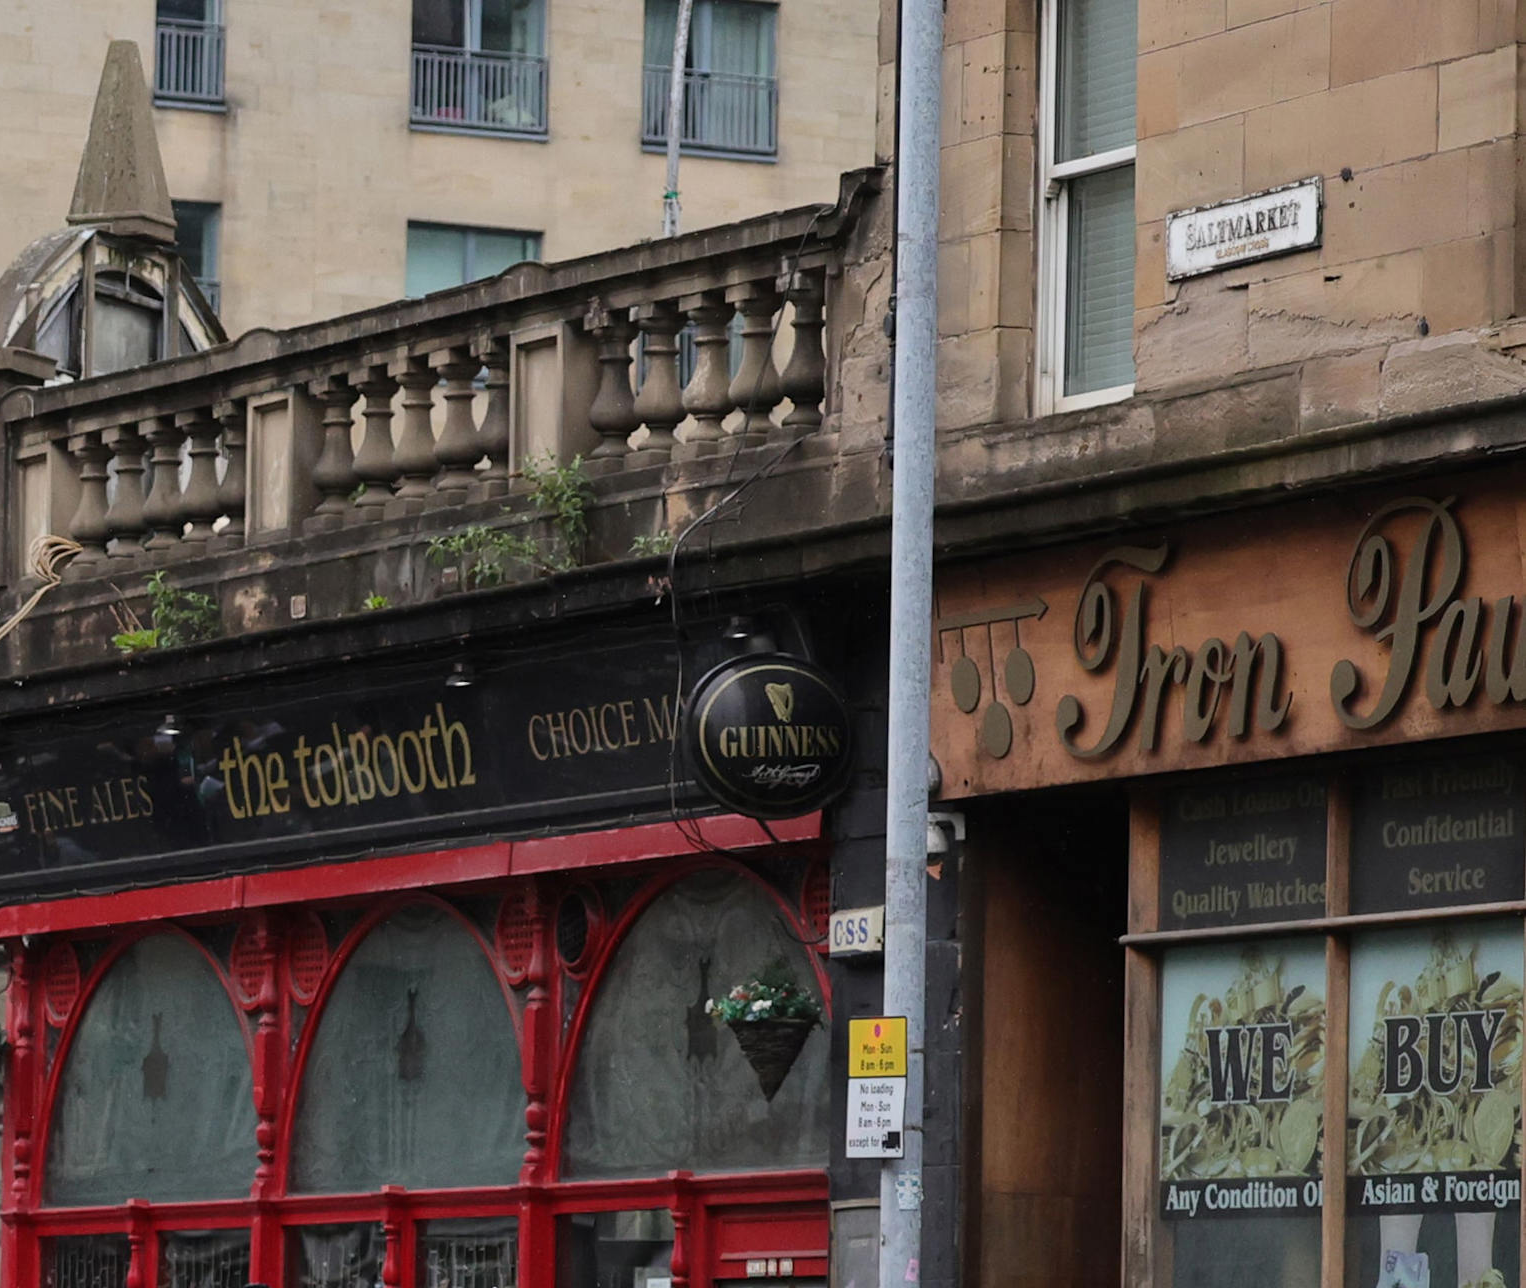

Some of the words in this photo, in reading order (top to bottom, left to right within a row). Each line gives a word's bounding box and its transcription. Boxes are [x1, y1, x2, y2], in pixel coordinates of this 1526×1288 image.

[1186, 200, 1300, 250] SALTMARKET
[528, 701, 640, 761] CHOICE
[719, 725, 842, 758] GUINNESS
[219, 735, 290, 819] the
[24, 789, 82, 834] FINE
[90, 775, 154, 826] ALES
[1383, 809, 1513, 849] Confidential
[1203, 833, 1297, 868] Jewellery
[1172, 885, 1242, 918] Quality
[1247, 878, 1329, 911] Watches
[1408, 868, 1485, 895] Service
[863, 1043, 876, 1053] Mon
[880, 1043, 893, 1053] Sun
[1206, 1022, 1295, 1105] WE
[1384, 1011, 1506, 1096] BUY
[860, 1084, 869, 1095] No
[870, 1083, 893, 1097] loading
[861, 1101, 876, 1112] Mon
[879, 1101, 891, 1112] Sun
[849, 1137, 869, 1149] except
[871, 1136, 880, 1148] for
[1166, 1184, 1200, 1217] Any
[1204, 1182, 1298, 1210] Condition
[1362, 1179, 1414, 1205] Asian
[1420, 1175, 1439, 1202] &
[1444, 1174, 1520, 1208] Foreign
